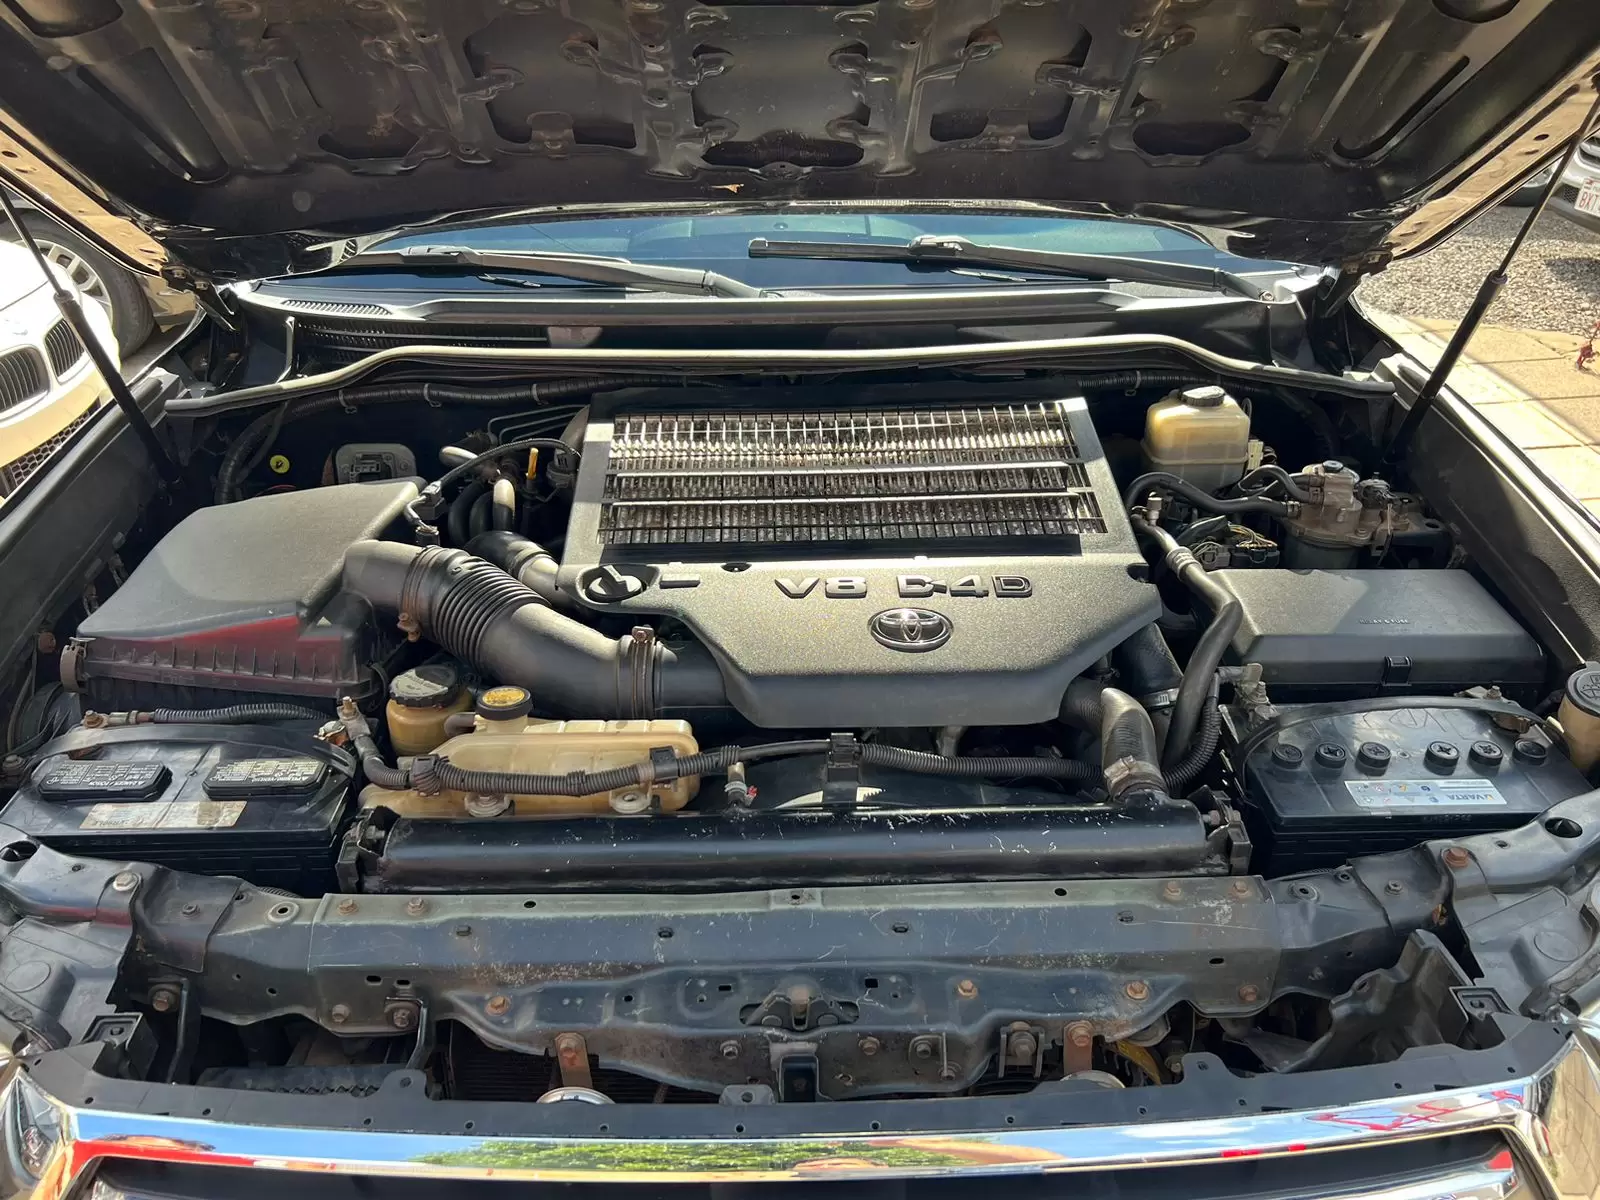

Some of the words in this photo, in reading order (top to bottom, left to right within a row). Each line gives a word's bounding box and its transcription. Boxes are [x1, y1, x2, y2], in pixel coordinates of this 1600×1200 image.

[774, 576, 867, 599] V8
[896, 574, 1032, 598] D-4D
[1446, 793, 1486, 801] VARTA
